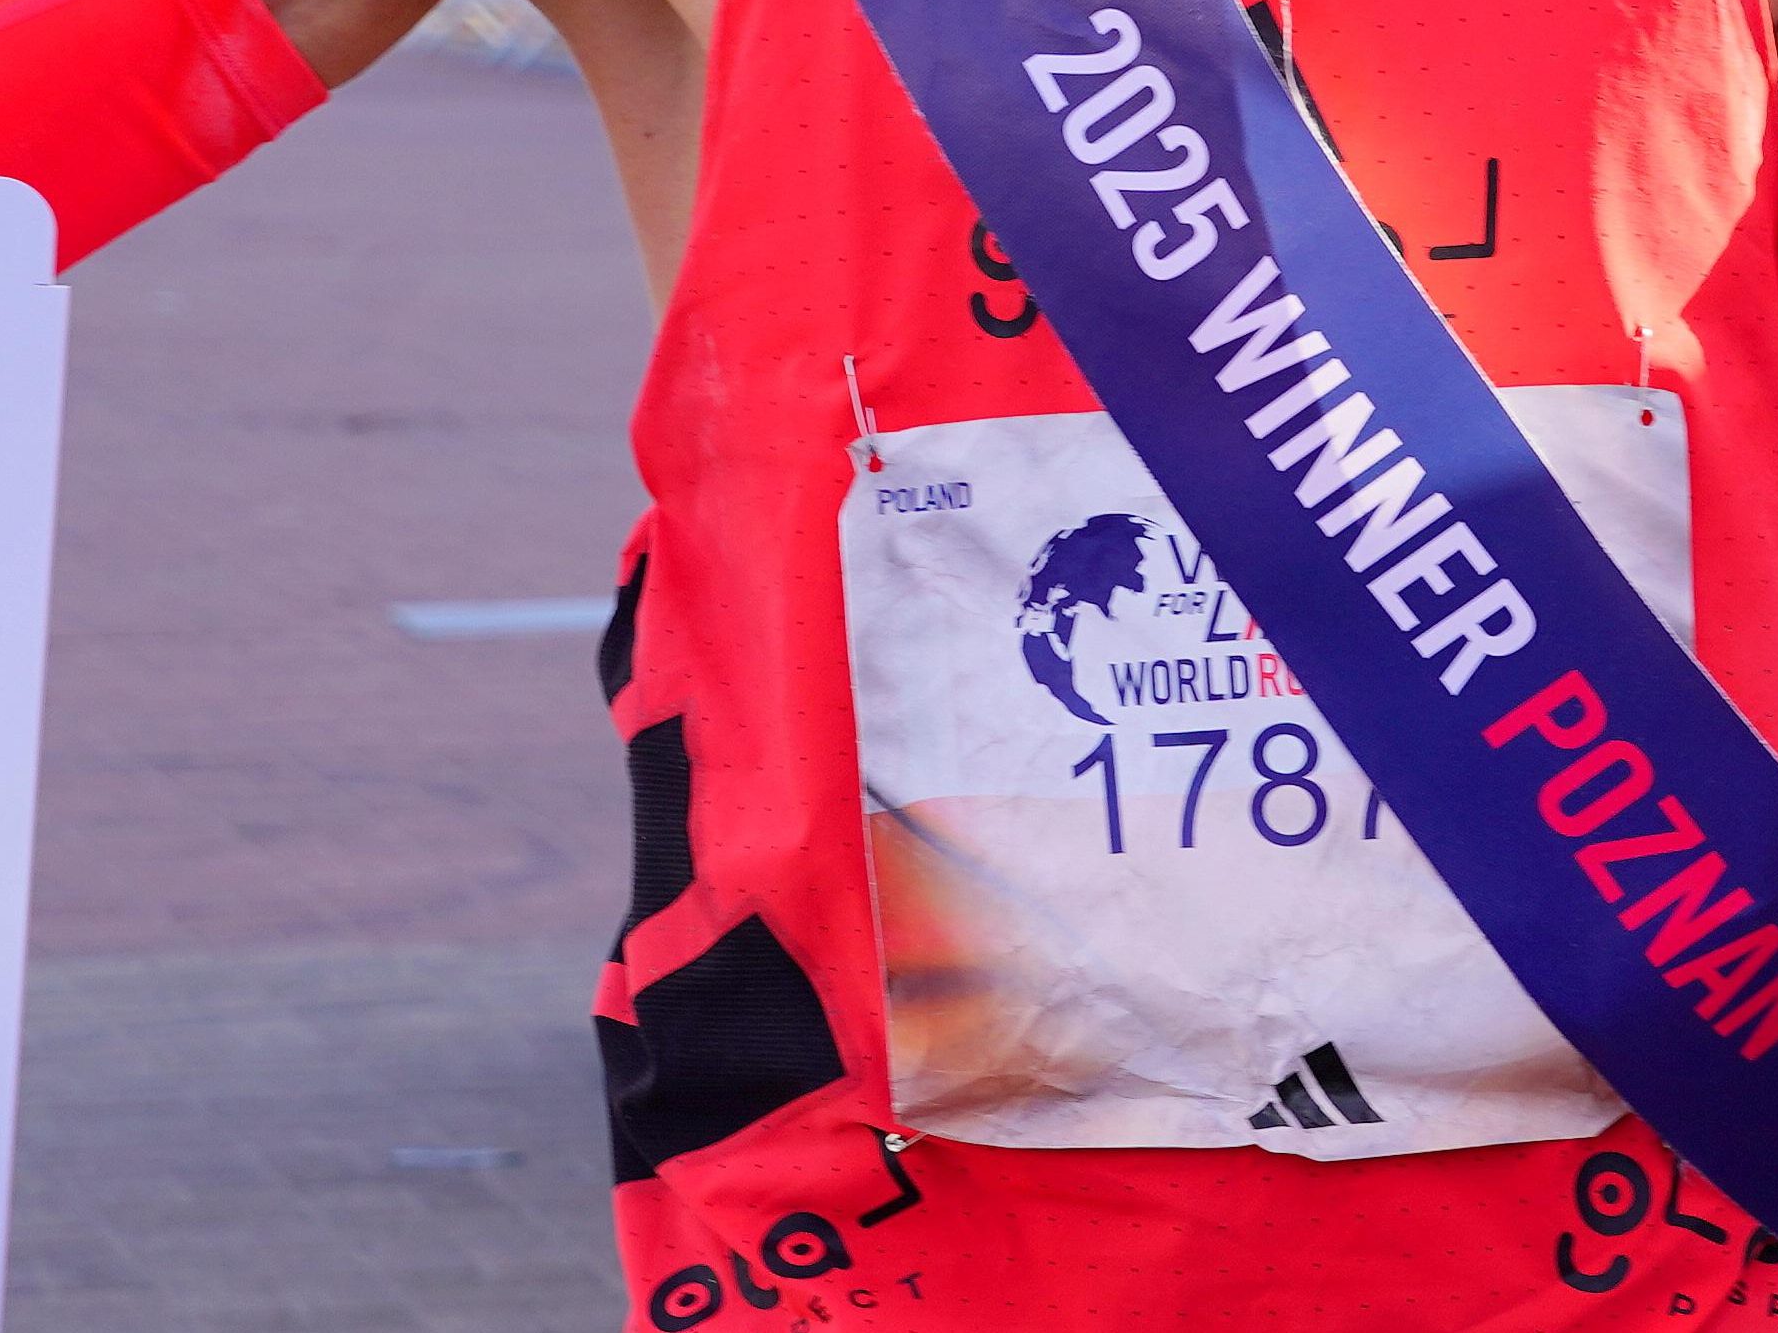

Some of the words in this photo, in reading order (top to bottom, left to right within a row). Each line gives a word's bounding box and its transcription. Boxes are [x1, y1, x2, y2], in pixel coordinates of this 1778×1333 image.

[1023, 8, 1250, 281] 2025
[1187, 255, 1537, 695] WINNER
[877, 482, 971, 515] POLAND
[1155, 591, 1207, 617] FOR
[1111, 654, 1250, 707] WORLD
